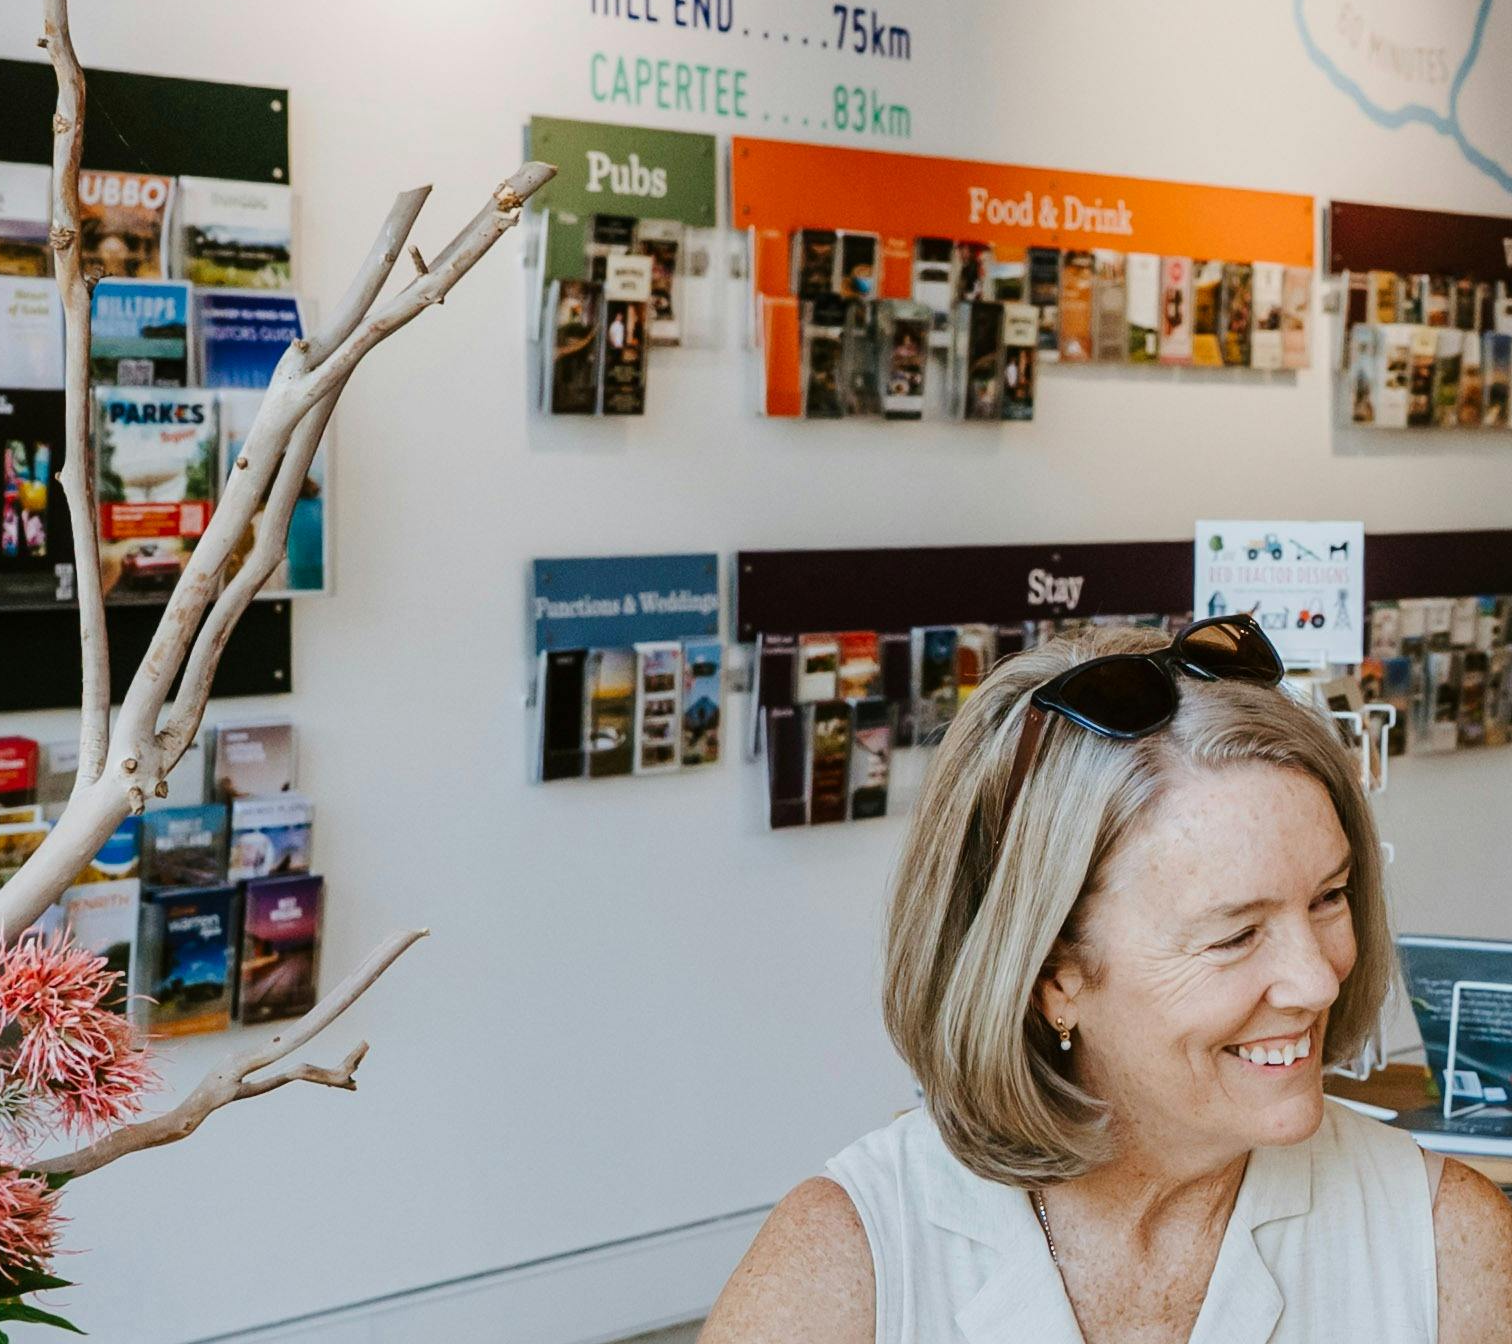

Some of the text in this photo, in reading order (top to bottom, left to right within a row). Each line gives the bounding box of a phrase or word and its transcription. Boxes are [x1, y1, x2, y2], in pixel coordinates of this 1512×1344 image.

[832, 4, 912, 61] 75km
[589, 52, 912, 140] CAPERTEE 83km
[80, 173, 168, 210] UBBO
[584, 149, 669, 201] Pubs
[967, 186, 1136, 238] Food & Drink
[109, 401, 205, 425] PARKES
[1027, 569, 1085, 610] Stay
[1208, 565, 1351, 585] RED TRACTOR DESIGNS
[534, 593, 621, 619] Functions
